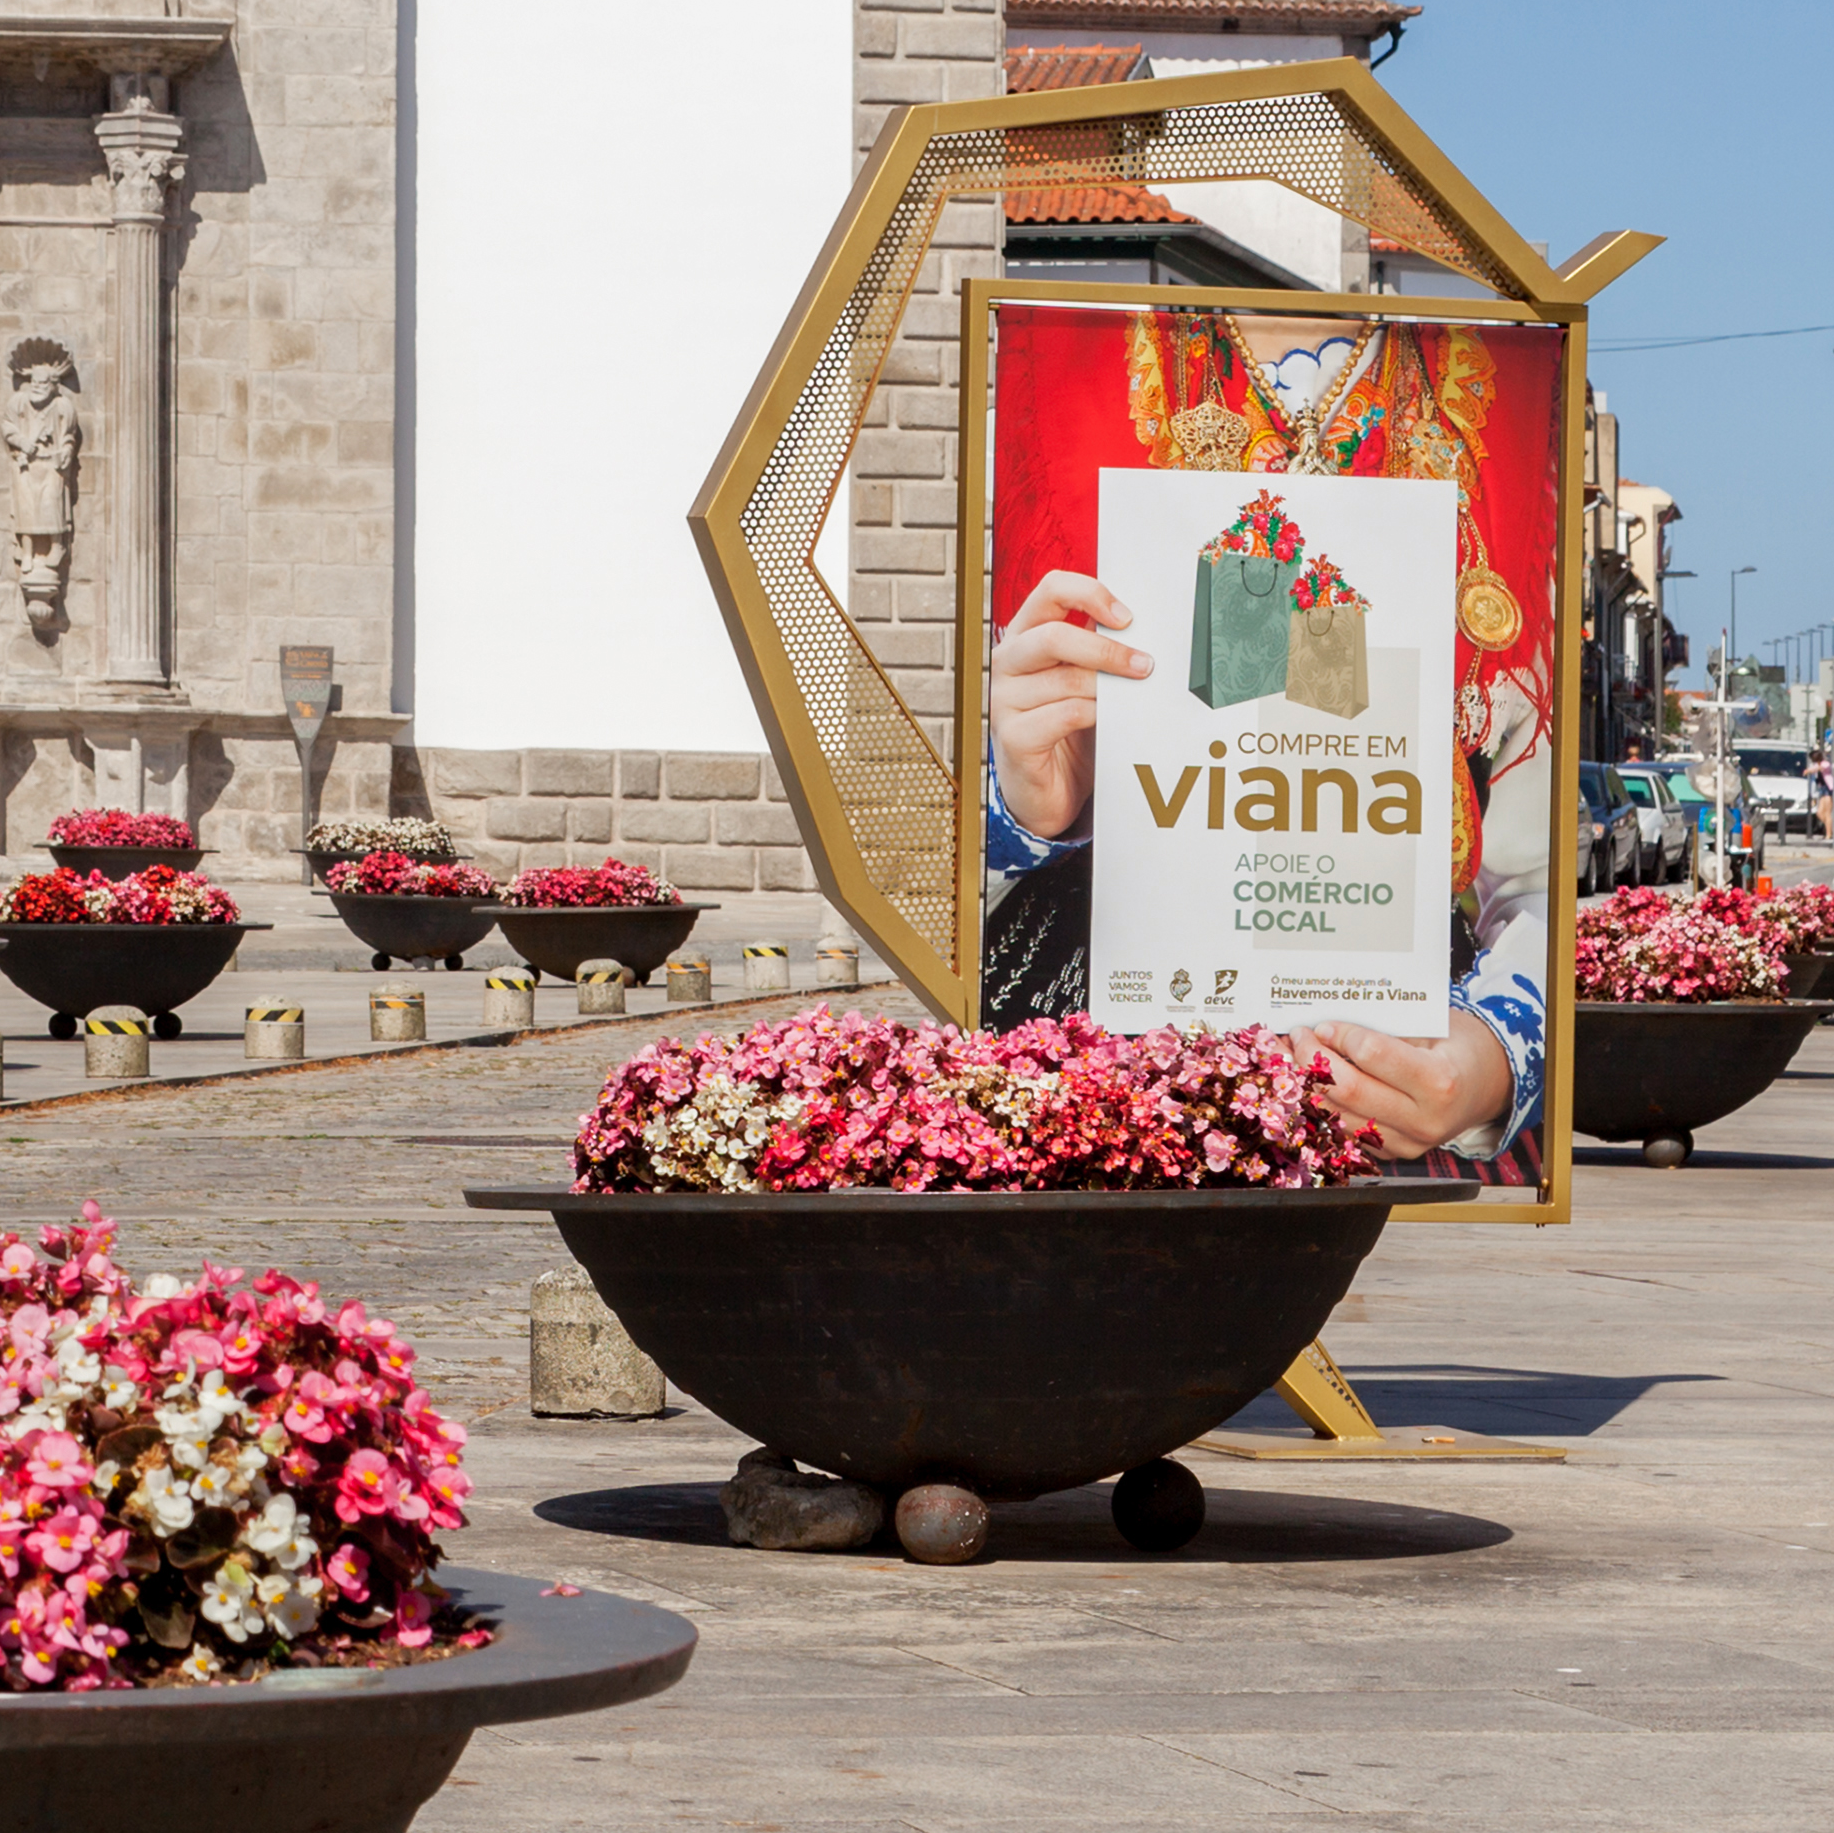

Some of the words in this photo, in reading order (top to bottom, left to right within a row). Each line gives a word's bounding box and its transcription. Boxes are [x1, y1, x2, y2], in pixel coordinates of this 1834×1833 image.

[1238, 732, 1360, 757] COMPRE
[1367, 736, 1407, 758] EM
[1133, 740, 1422, 835] viana
[1234, 853, 1311, 874] APOIE
[1316, 855, 1335, 874] O
[1233, 875, 1394, 905] COMÉRCIO
[1234, 909, 1336, 933] LOCAL
[1109, 970, 1153, 980] JUNTOS
[1109, 982, 1147, 991] VAMOS
[1305, 978, 1330, 986] amor
[1332, 977, 1344, 986] de
[1346, 977, 1376, 988] algum
[1378, 977, 1392, 987] dia
[1109, 993, 1153, 1002] VENCER
[1204, 995, 1235, 1005] aevc
[1271, 987, 1339, 1000] Havemos
[1342, 988, 1360, 1000] de
[1363, 988, 1373, 1000] ir
[1375, 992, 1384, 1000] a
[1387, 989, 1427, 1001] Viana
